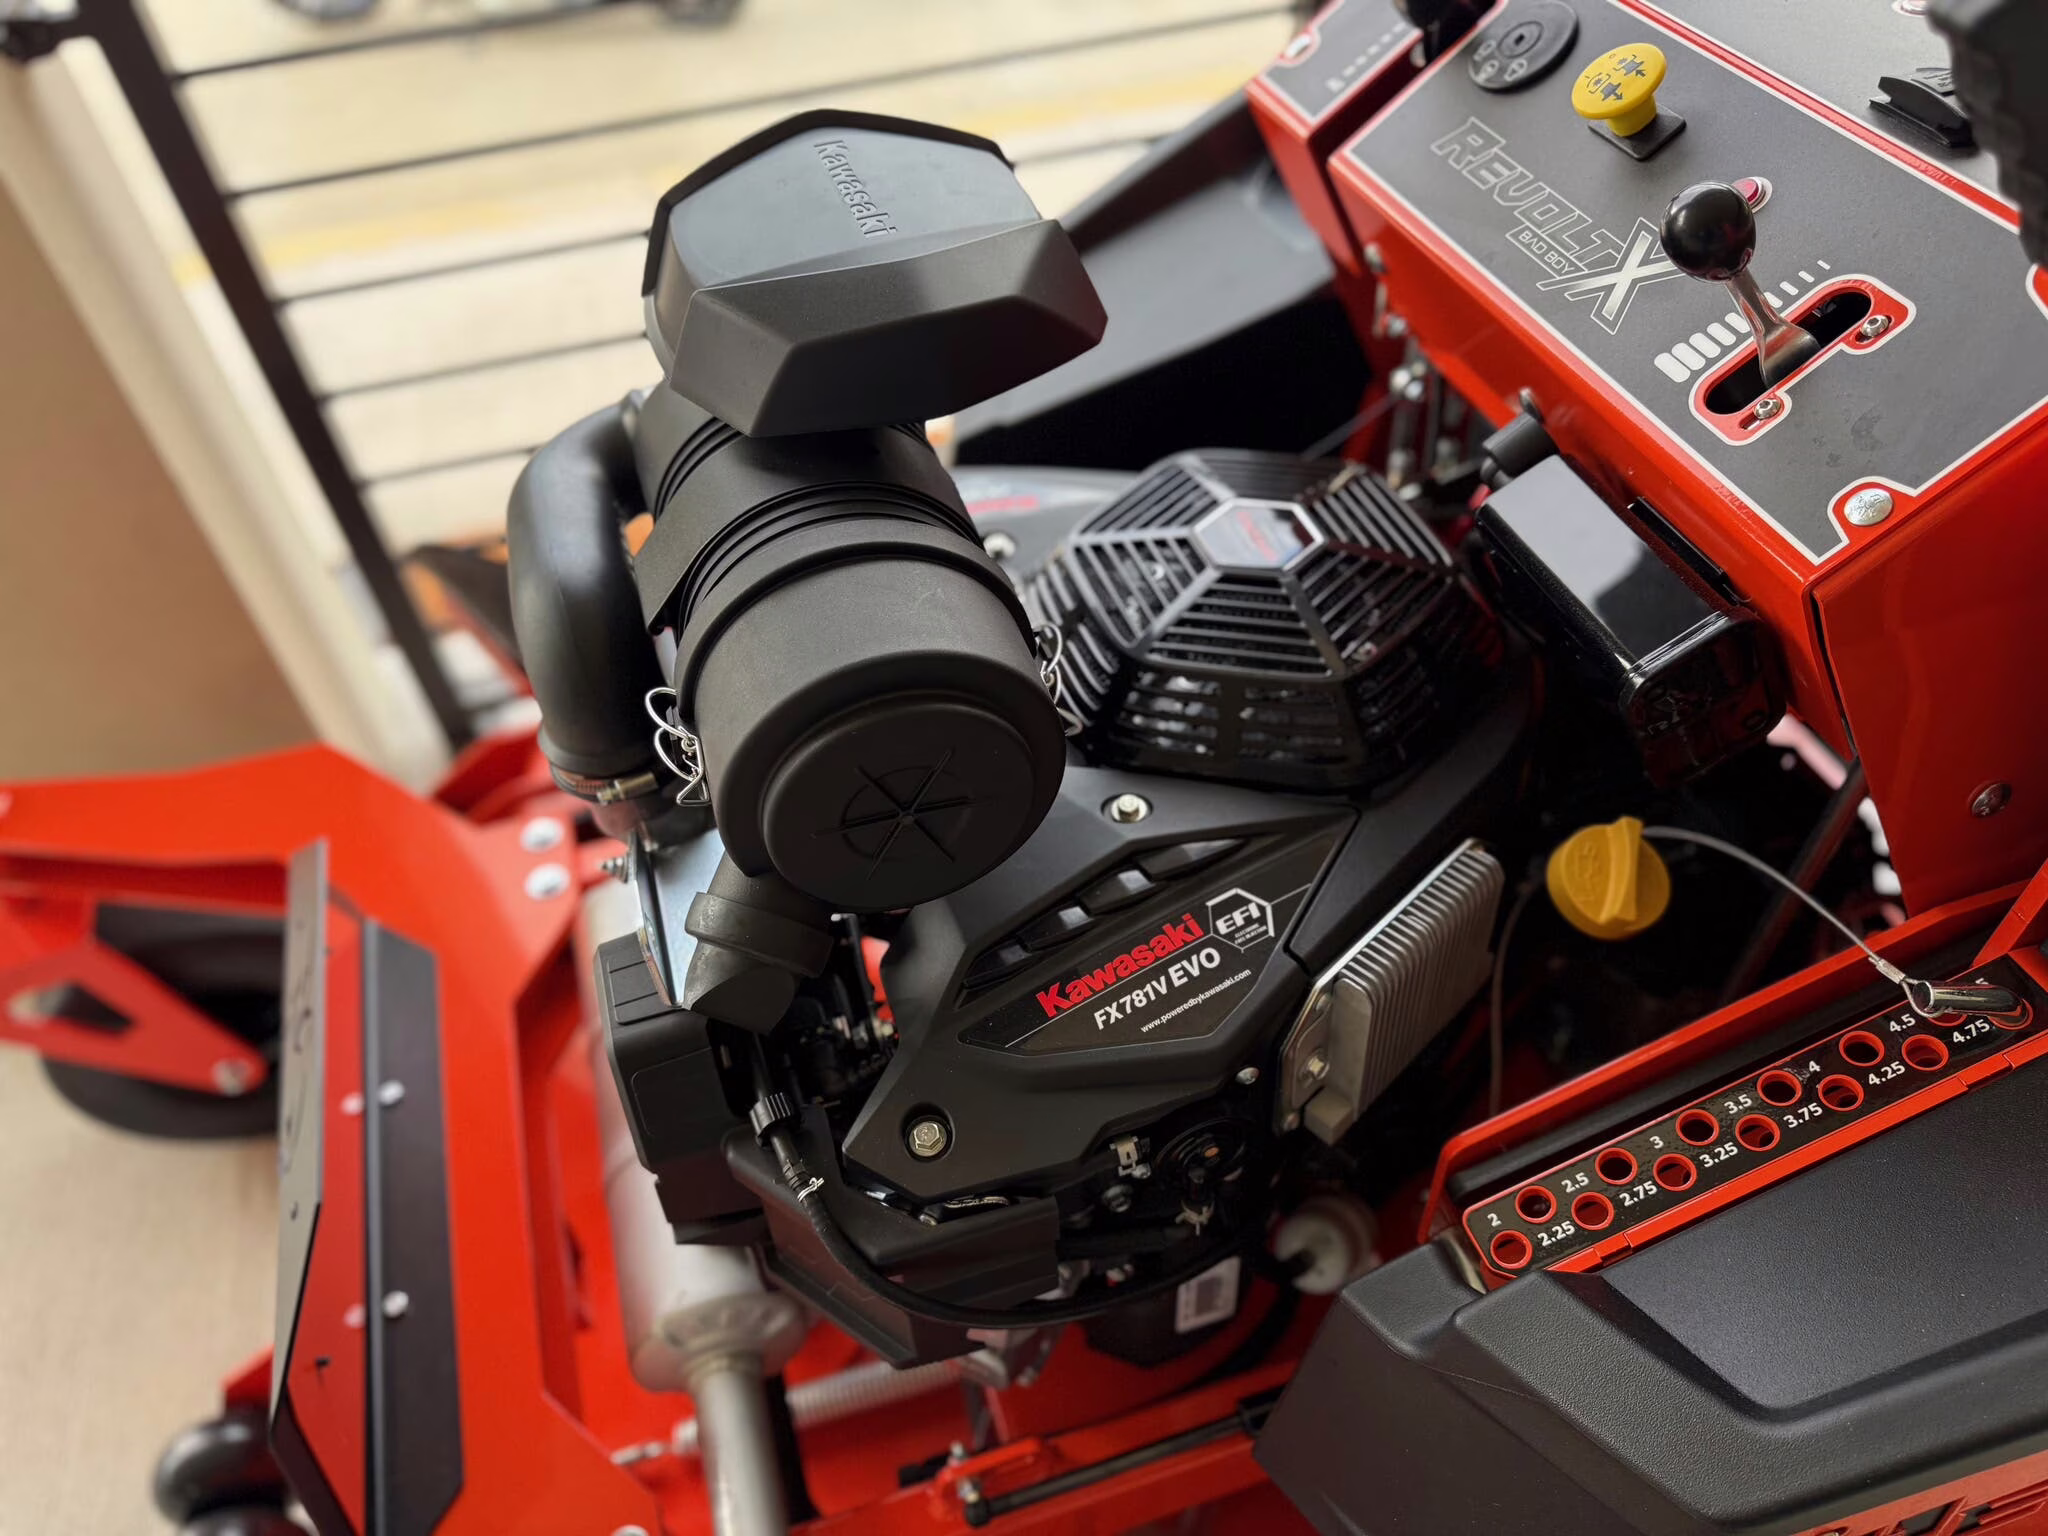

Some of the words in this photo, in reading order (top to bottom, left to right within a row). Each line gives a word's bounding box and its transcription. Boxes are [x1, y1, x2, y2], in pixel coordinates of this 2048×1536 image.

[813, 140, 898, 238] Kawasaki
[1518, 230, 1548, 255] BAD
[1544, 250, 1575, 274] BOY
[1215, 902, 1261, 935] EFI
[1036, 913, 1205, 1019] Kawasaki
[1093, 975, 1168, 1030] FX781V
[1167, 947, 1221, 988] EVO
[1140, 968, 1252, 1033] www.poweredbykawasaki.com
[1889, 1013, 1916, 1032] 4.5
[1953, 1018, 1990, 1043] 4.75
[1808, 1060, 1821, 1073] 4
[1868, 1060, 1906, 1085] 4.25
[1723, 1093, 1753, 1115] 3.5
[1782, 1102, 1823, 1129] 3.75
[1649, 1135, 1664, 1149] 3
[1699, 1141, 1738, 1168] 3.25
[1561, 1171, 1590, 1194] 2.5
[1618, 1180, 1658, 1207] 2.75
[1486, 1212, 1502, 1227] 2
[1537, 1220, 1576, 1247] 2.25
